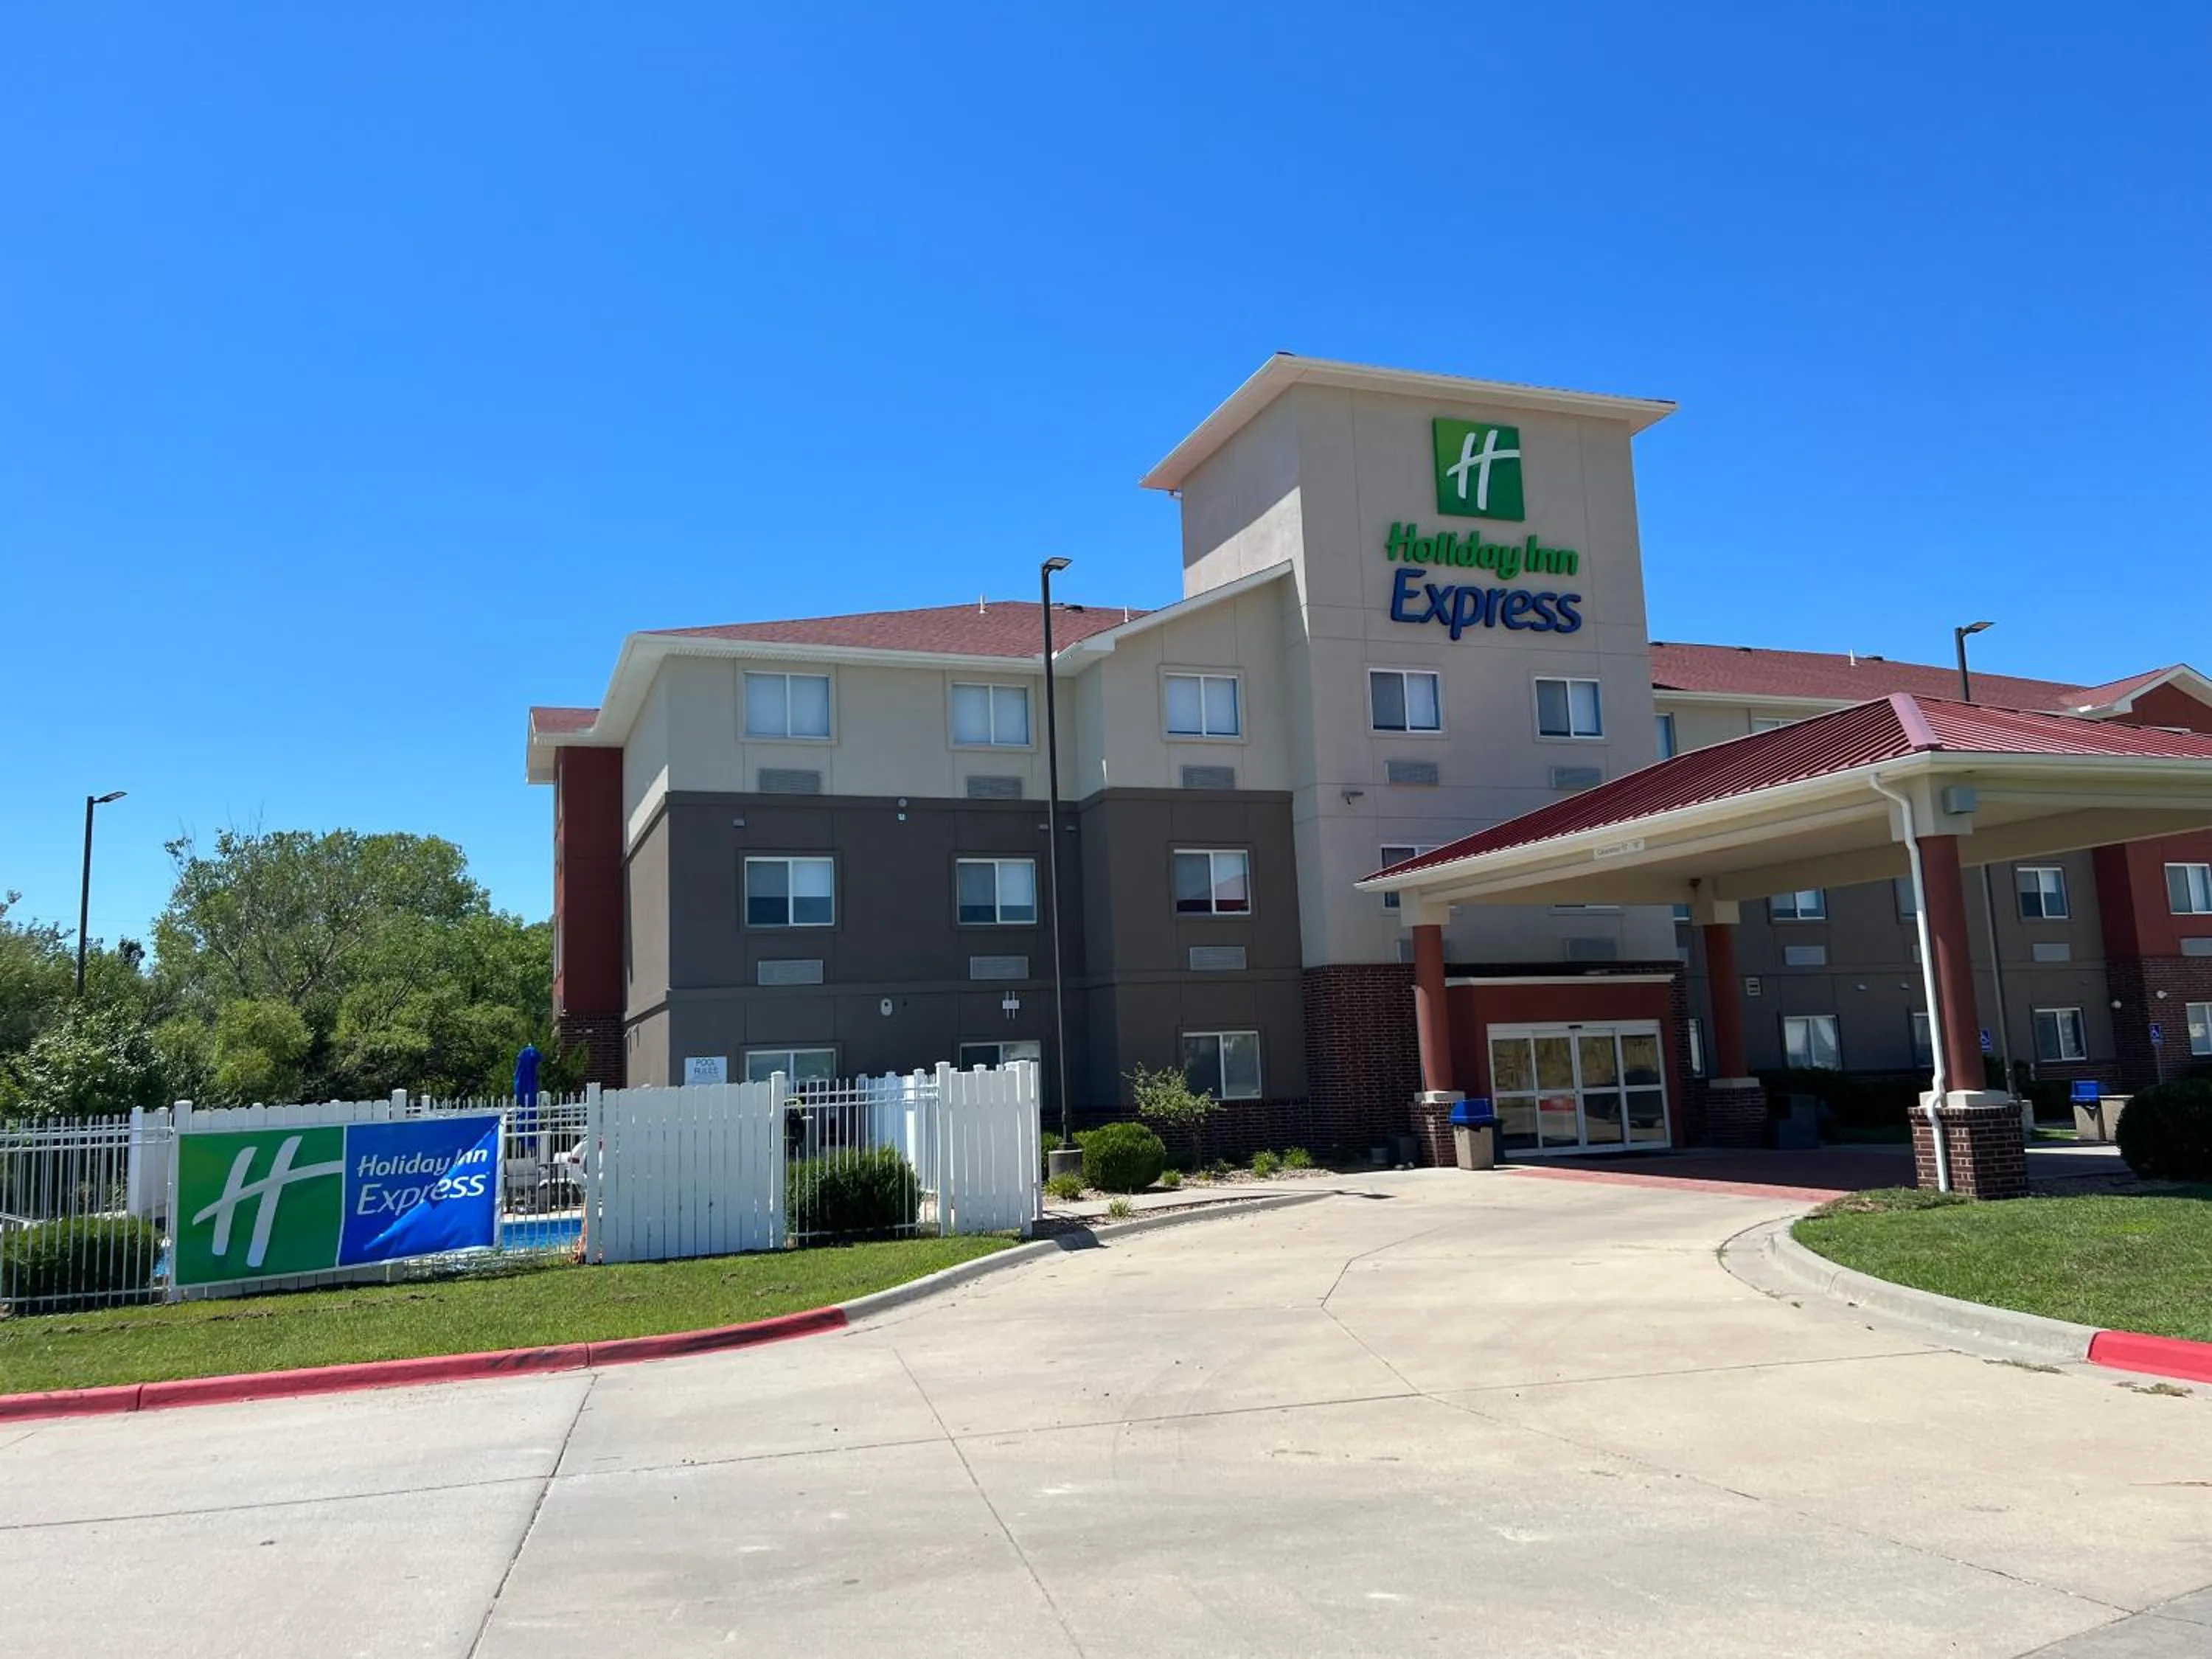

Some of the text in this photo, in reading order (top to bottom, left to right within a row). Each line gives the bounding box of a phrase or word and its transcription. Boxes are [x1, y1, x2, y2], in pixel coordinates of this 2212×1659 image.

[1385, 521, 1579, 580] Holiday Inn
[1391, 567, 1582, 641] Express
[357, 1148, 487, 1178] Holiday Inn
[357, 1174, 487, 1216] Express
